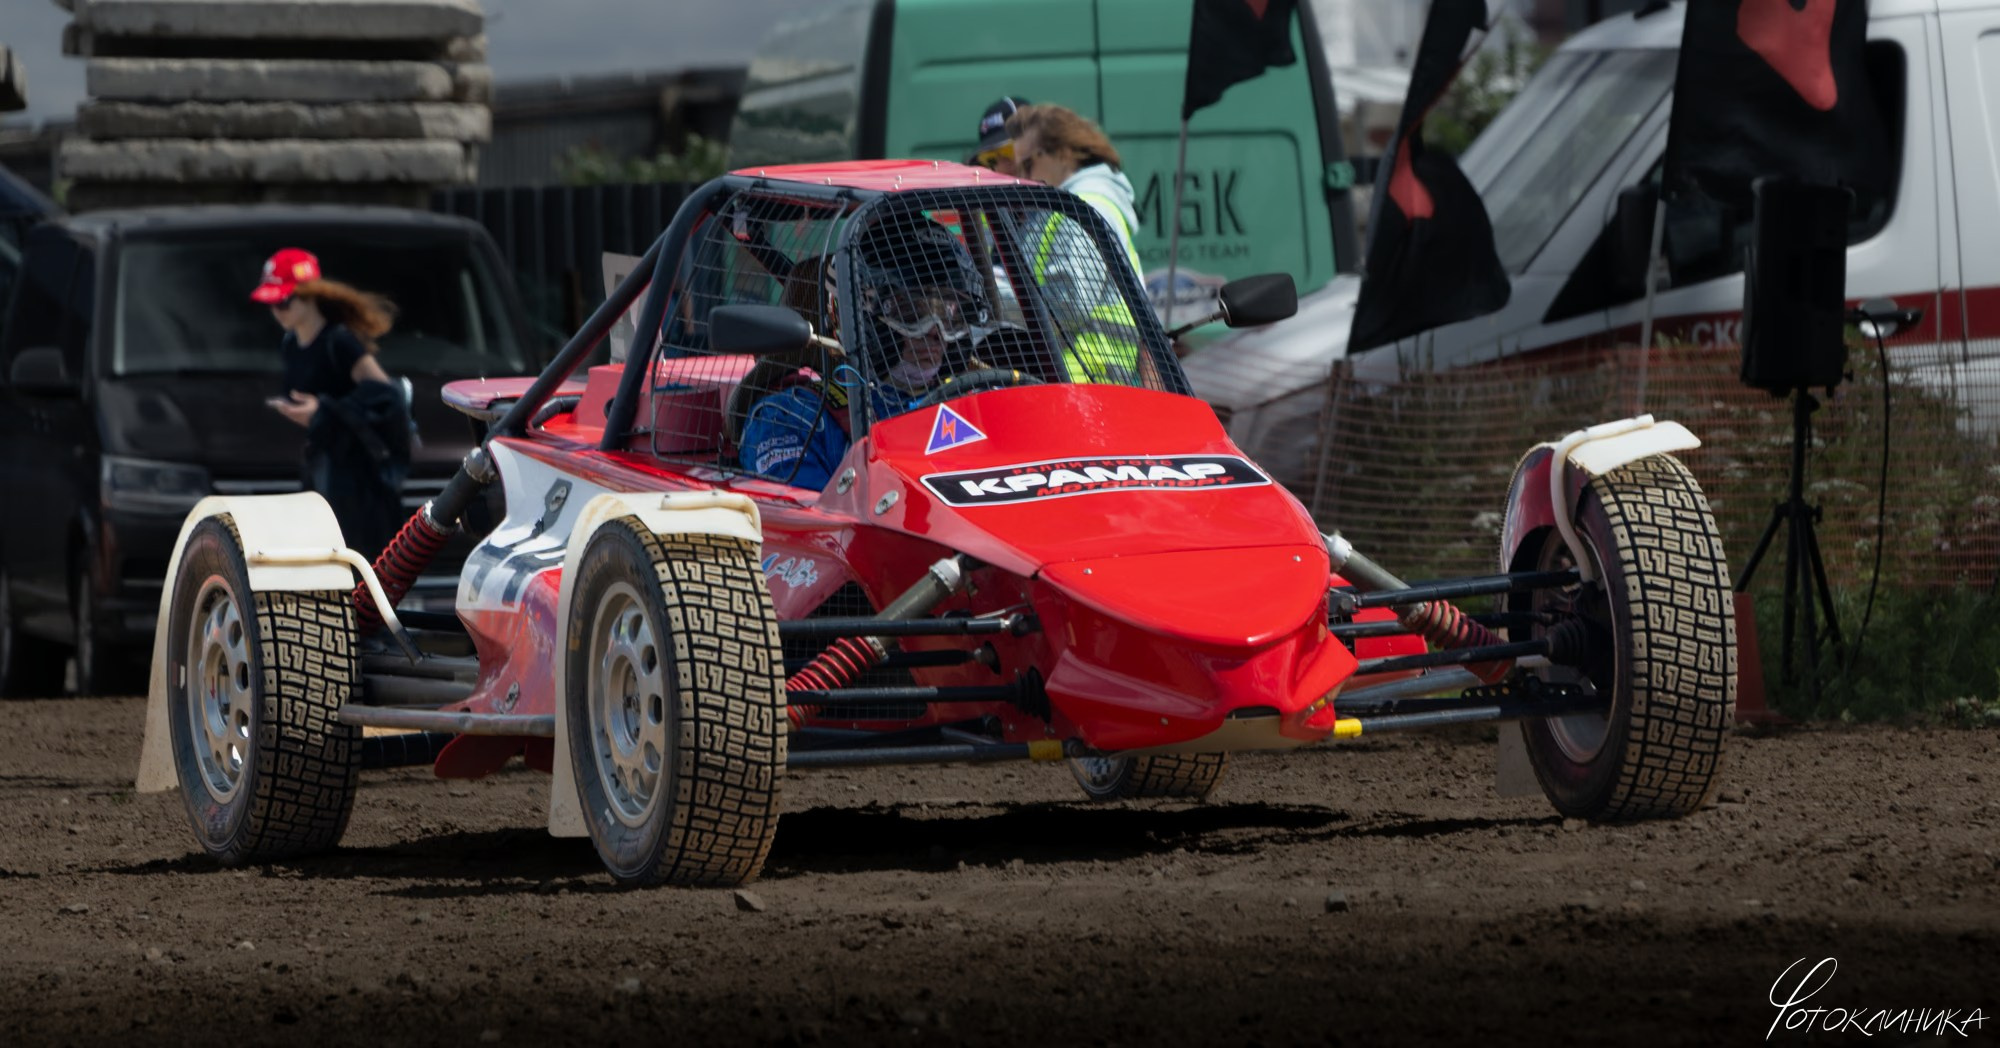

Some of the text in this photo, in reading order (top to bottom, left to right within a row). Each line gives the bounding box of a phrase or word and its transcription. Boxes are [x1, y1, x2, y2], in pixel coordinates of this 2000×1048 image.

[1199, 244, 1249, 260] TEAM
[959, 463, 1226, 497] КРАМАР
[1036, 475, 1234, 497] МОТОРСПОРТ
